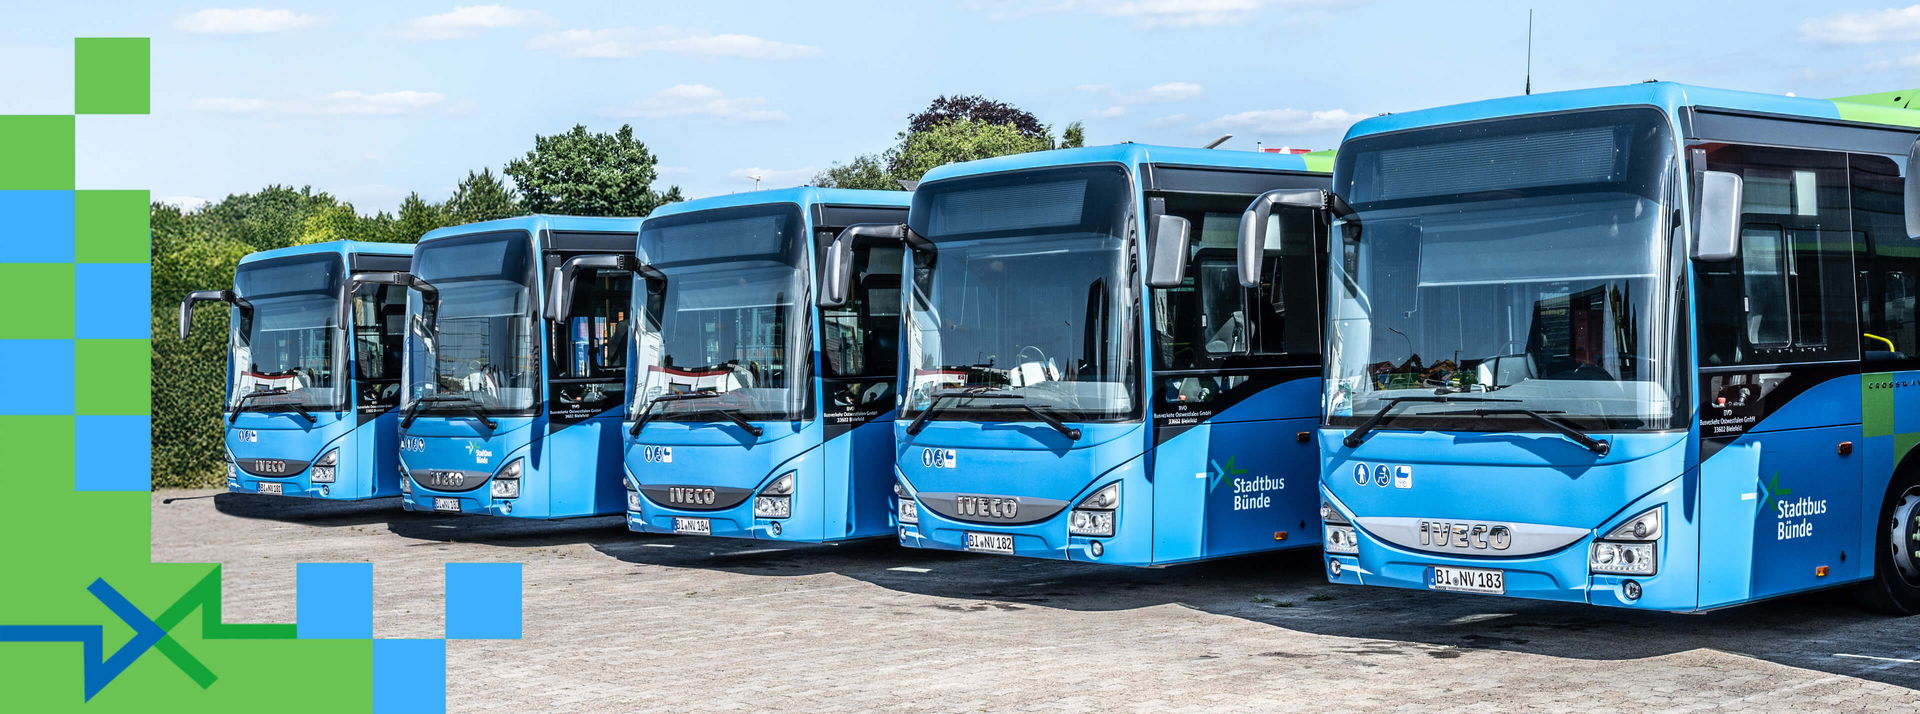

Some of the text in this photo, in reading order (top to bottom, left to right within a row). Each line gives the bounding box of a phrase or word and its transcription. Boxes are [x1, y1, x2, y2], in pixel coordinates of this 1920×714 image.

[255, 460, 286, 472] IVECO
[430, 472, 464, 486] IVECO
[1234, 475, 1285, 493] Stadtbus
[669, 488, 715, 505] IVECO
[1234, 492, 1270, 510] Bünde
[957, 496, 1017, 519] IVECO
[1778, 496, 1826, 519] Stadtbus
[698, 521, 708, 531] 184
[1778, 518, 1813, 540] Bünde
[969, 535, 1012, 550] BI NV 182
[1420, 522, 1511, 550] IVECO
[1436, 570, 1501, 588] BI NV 183
